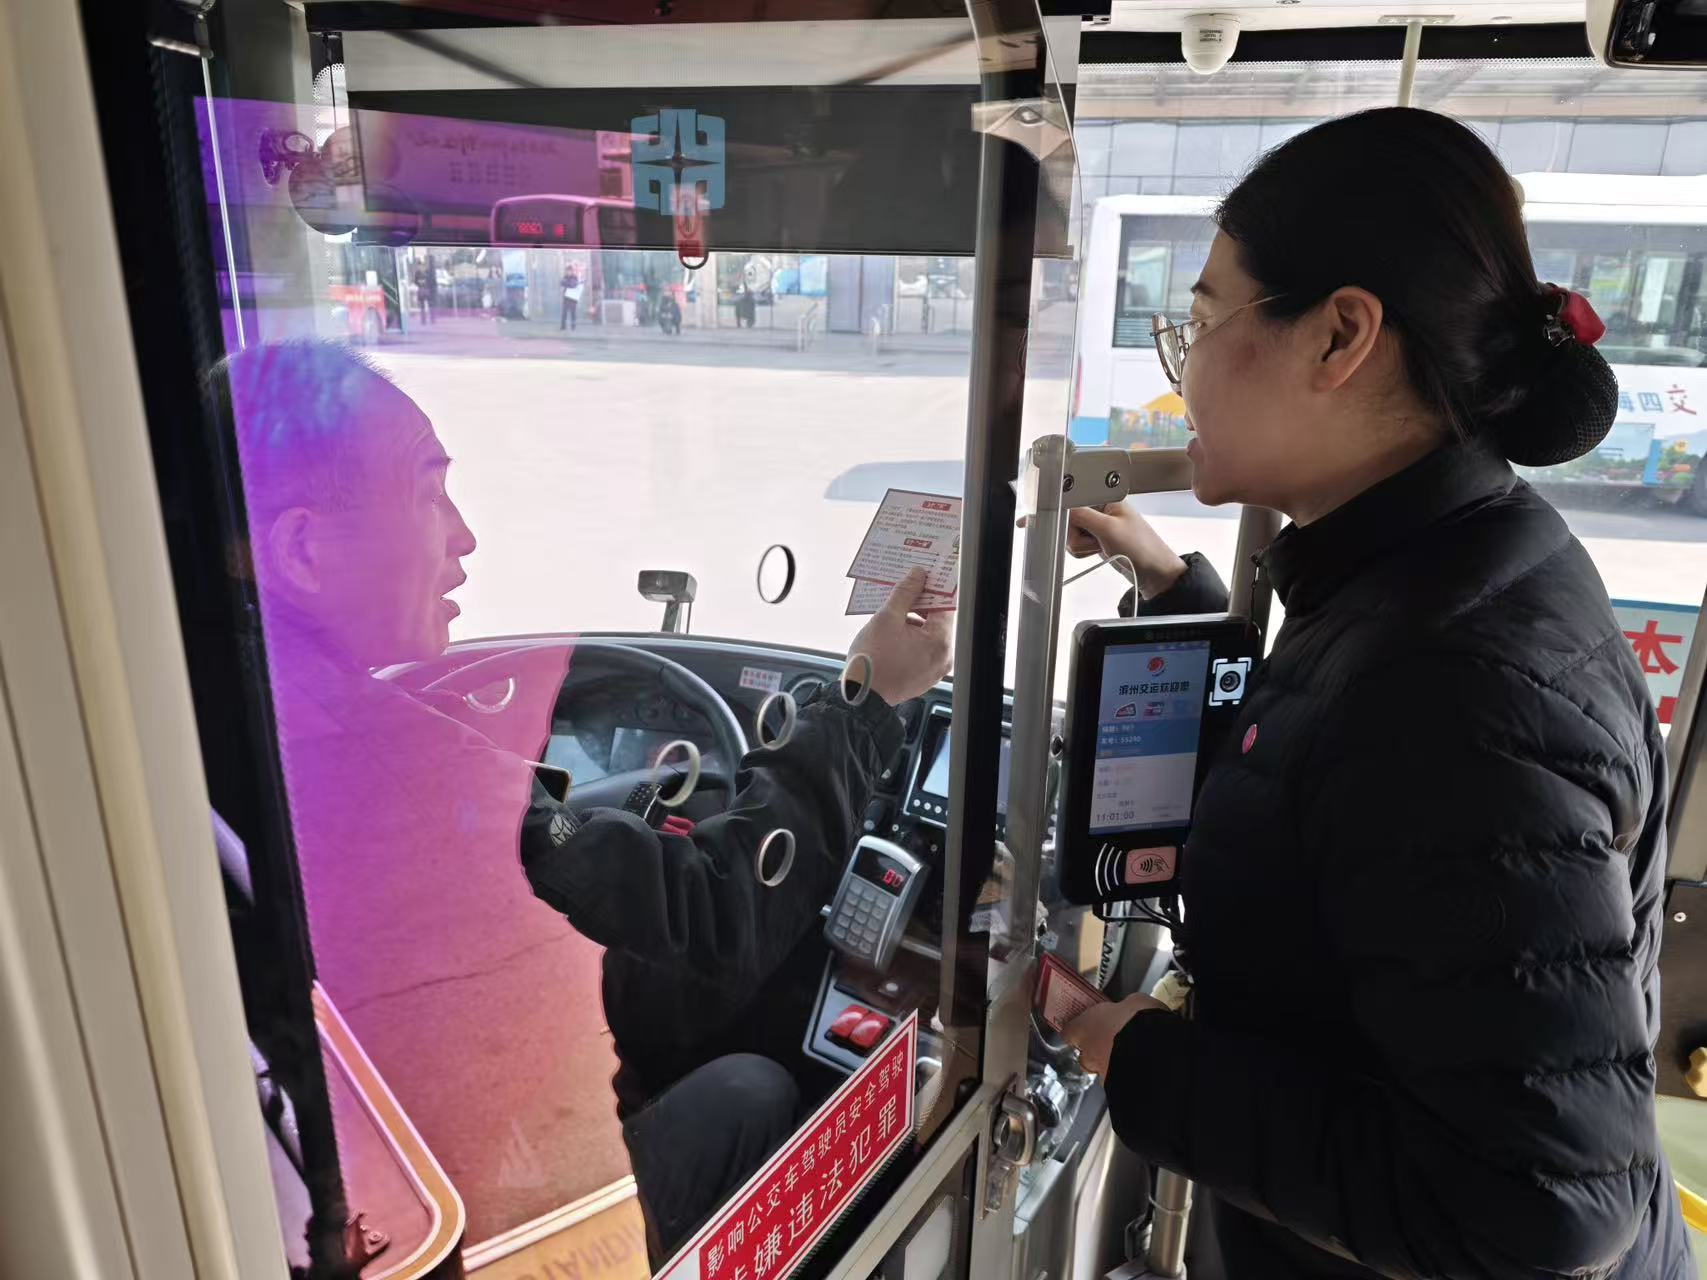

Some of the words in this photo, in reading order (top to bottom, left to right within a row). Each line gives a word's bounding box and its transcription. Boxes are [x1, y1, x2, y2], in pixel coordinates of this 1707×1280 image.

[1096, 810, 1135, 822] 11:01:00
[706, 1050, 905, 1279] 影响公交车驾驶员安全驾驶
